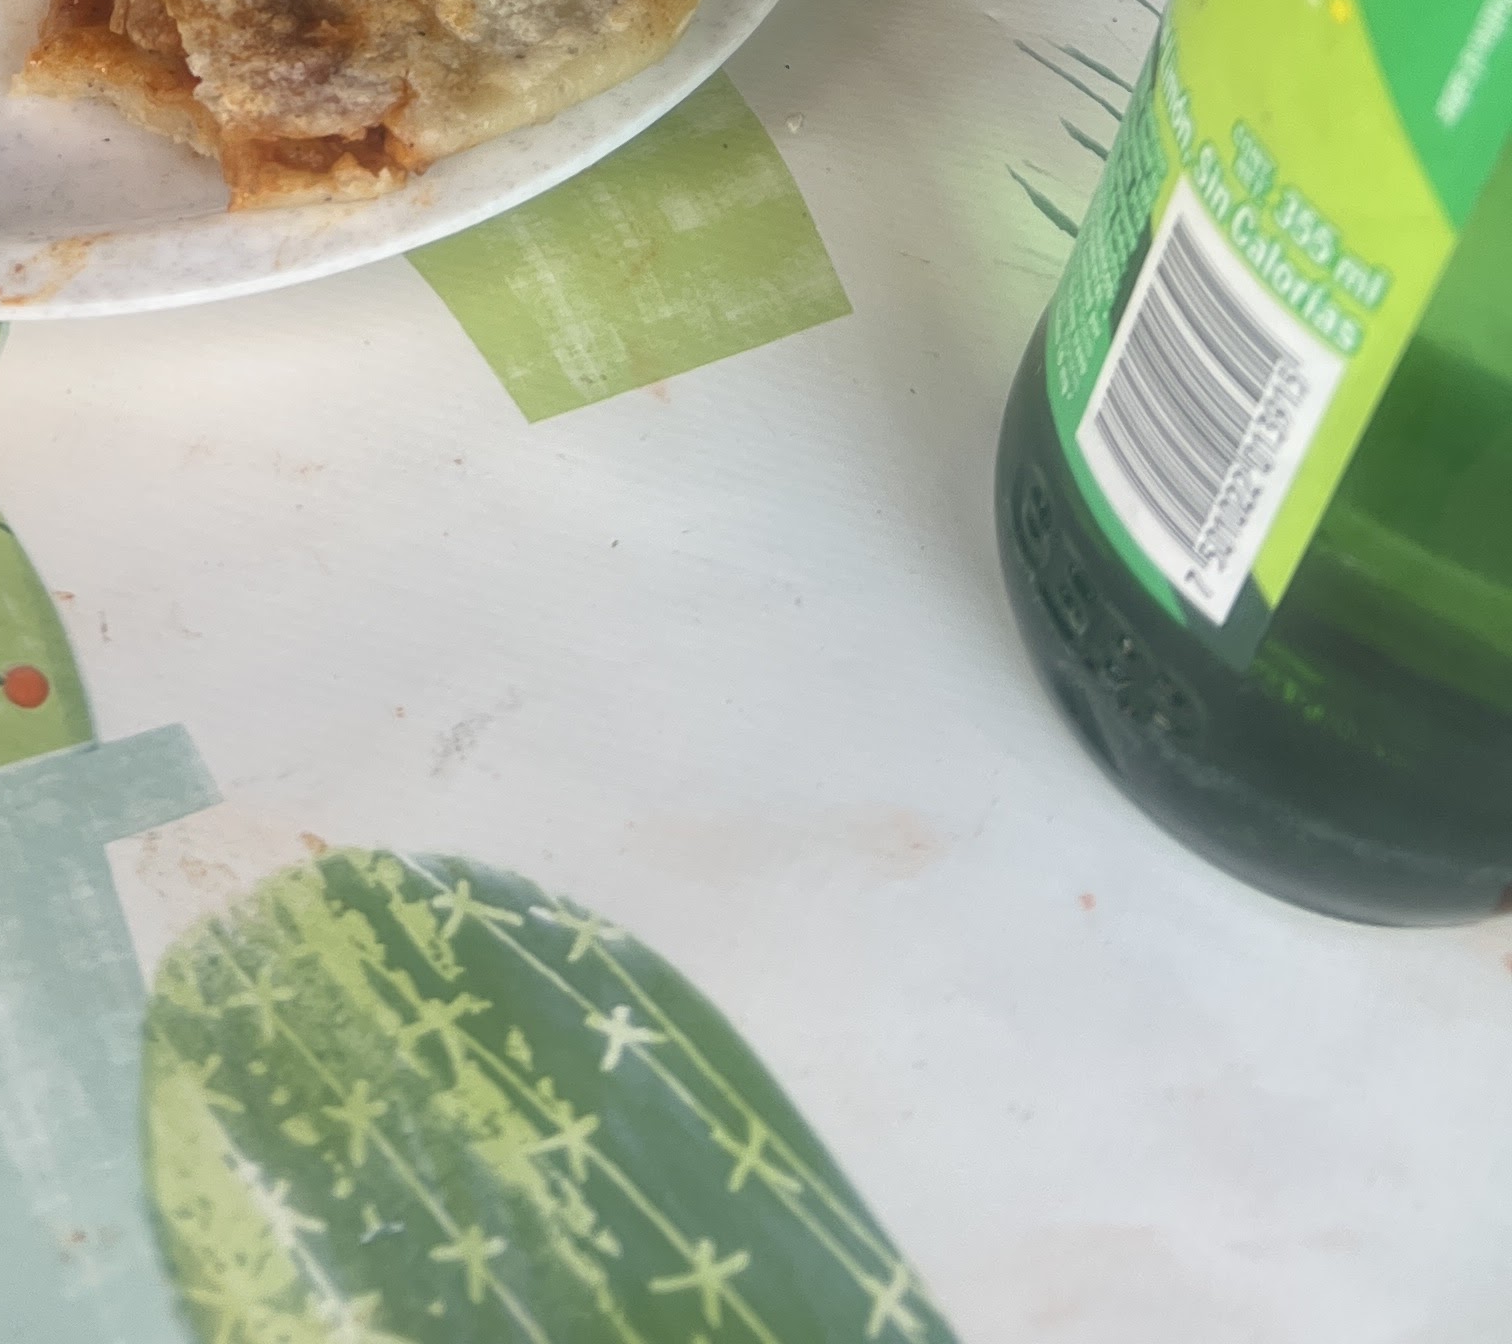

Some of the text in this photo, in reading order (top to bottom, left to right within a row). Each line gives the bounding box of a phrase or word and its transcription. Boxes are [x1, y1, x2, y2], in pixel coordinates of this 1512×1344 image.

[1194, 144, 1230, 220] Sin
[1275, 192, 1387, 306] 355 ml
[1184, 568, 1215, 600] 7
